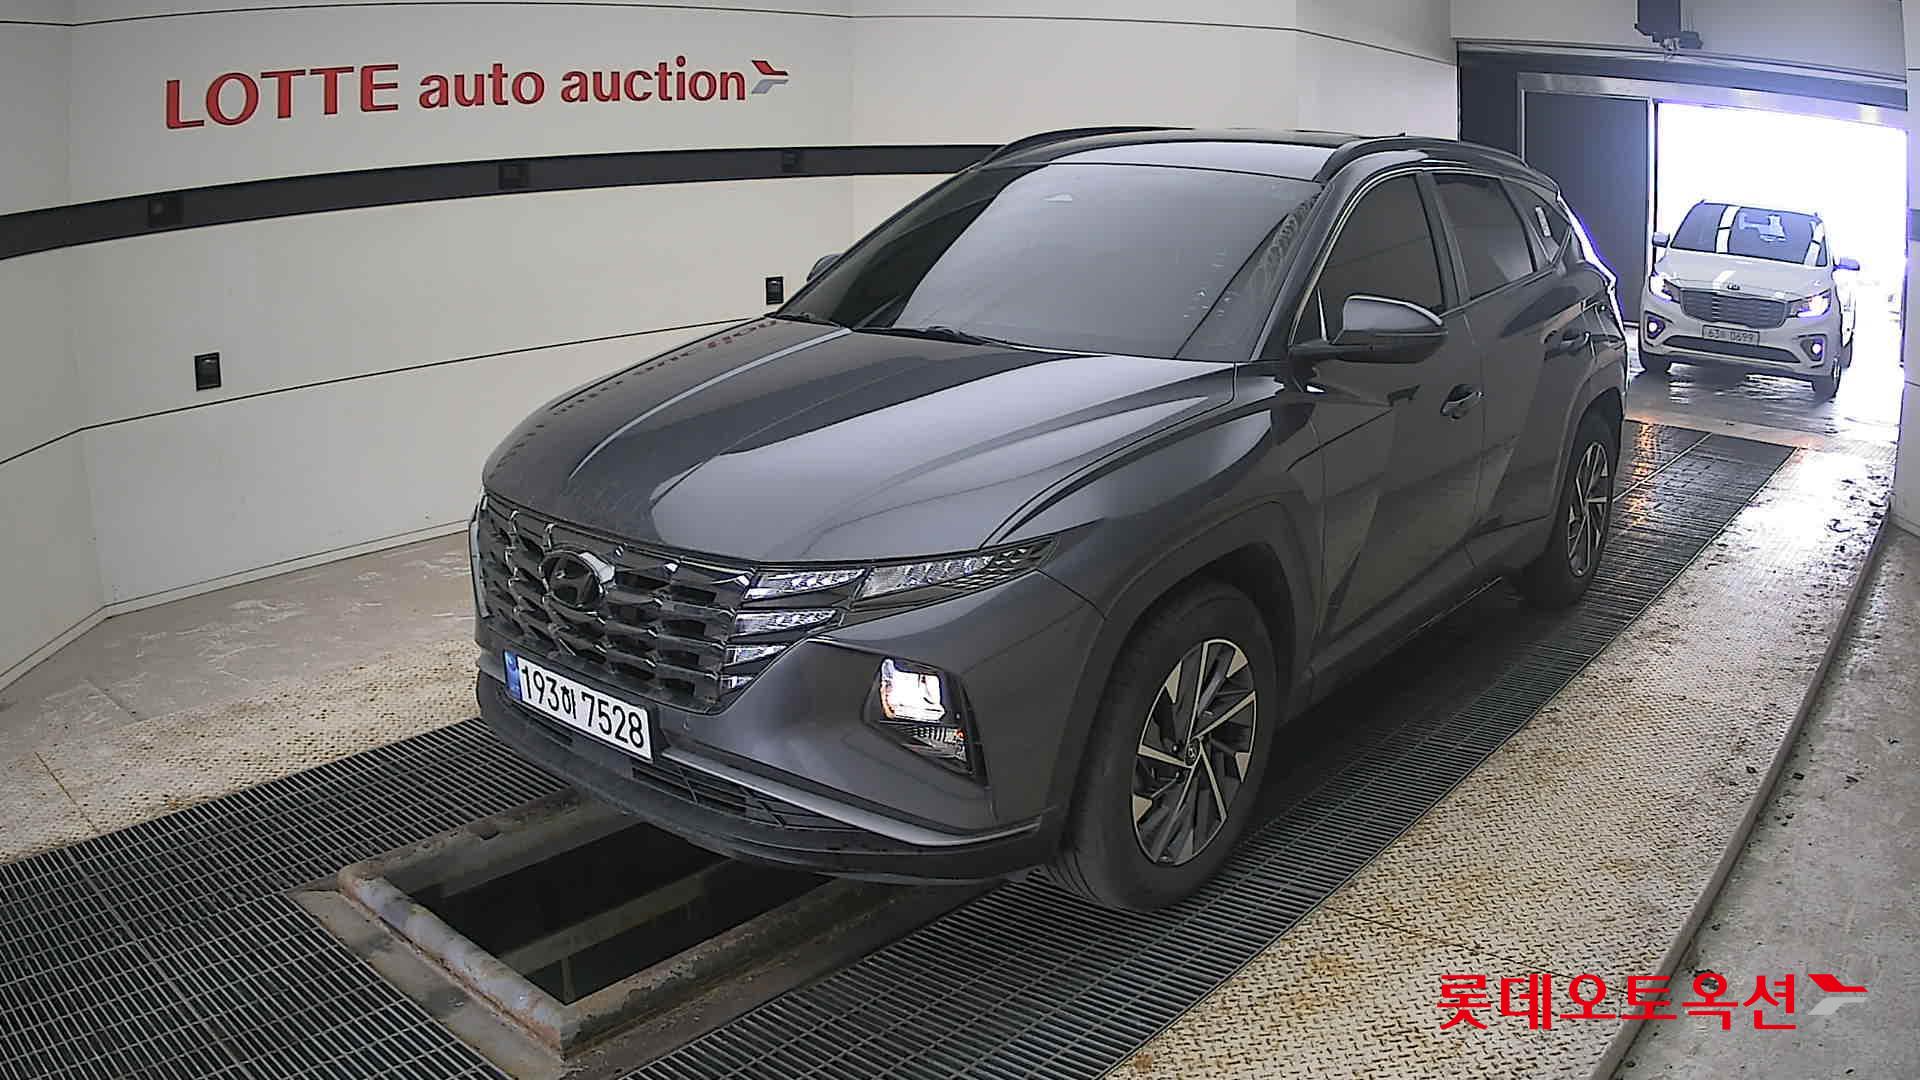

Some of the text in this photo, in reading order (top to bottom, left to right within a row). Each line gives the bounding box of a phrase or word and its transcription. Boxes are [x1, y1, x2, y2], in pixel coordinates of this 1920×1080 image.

[166, 55, 747, 130] LOTTE auto auction
[521, 665, 644, 748] 193하 7528
